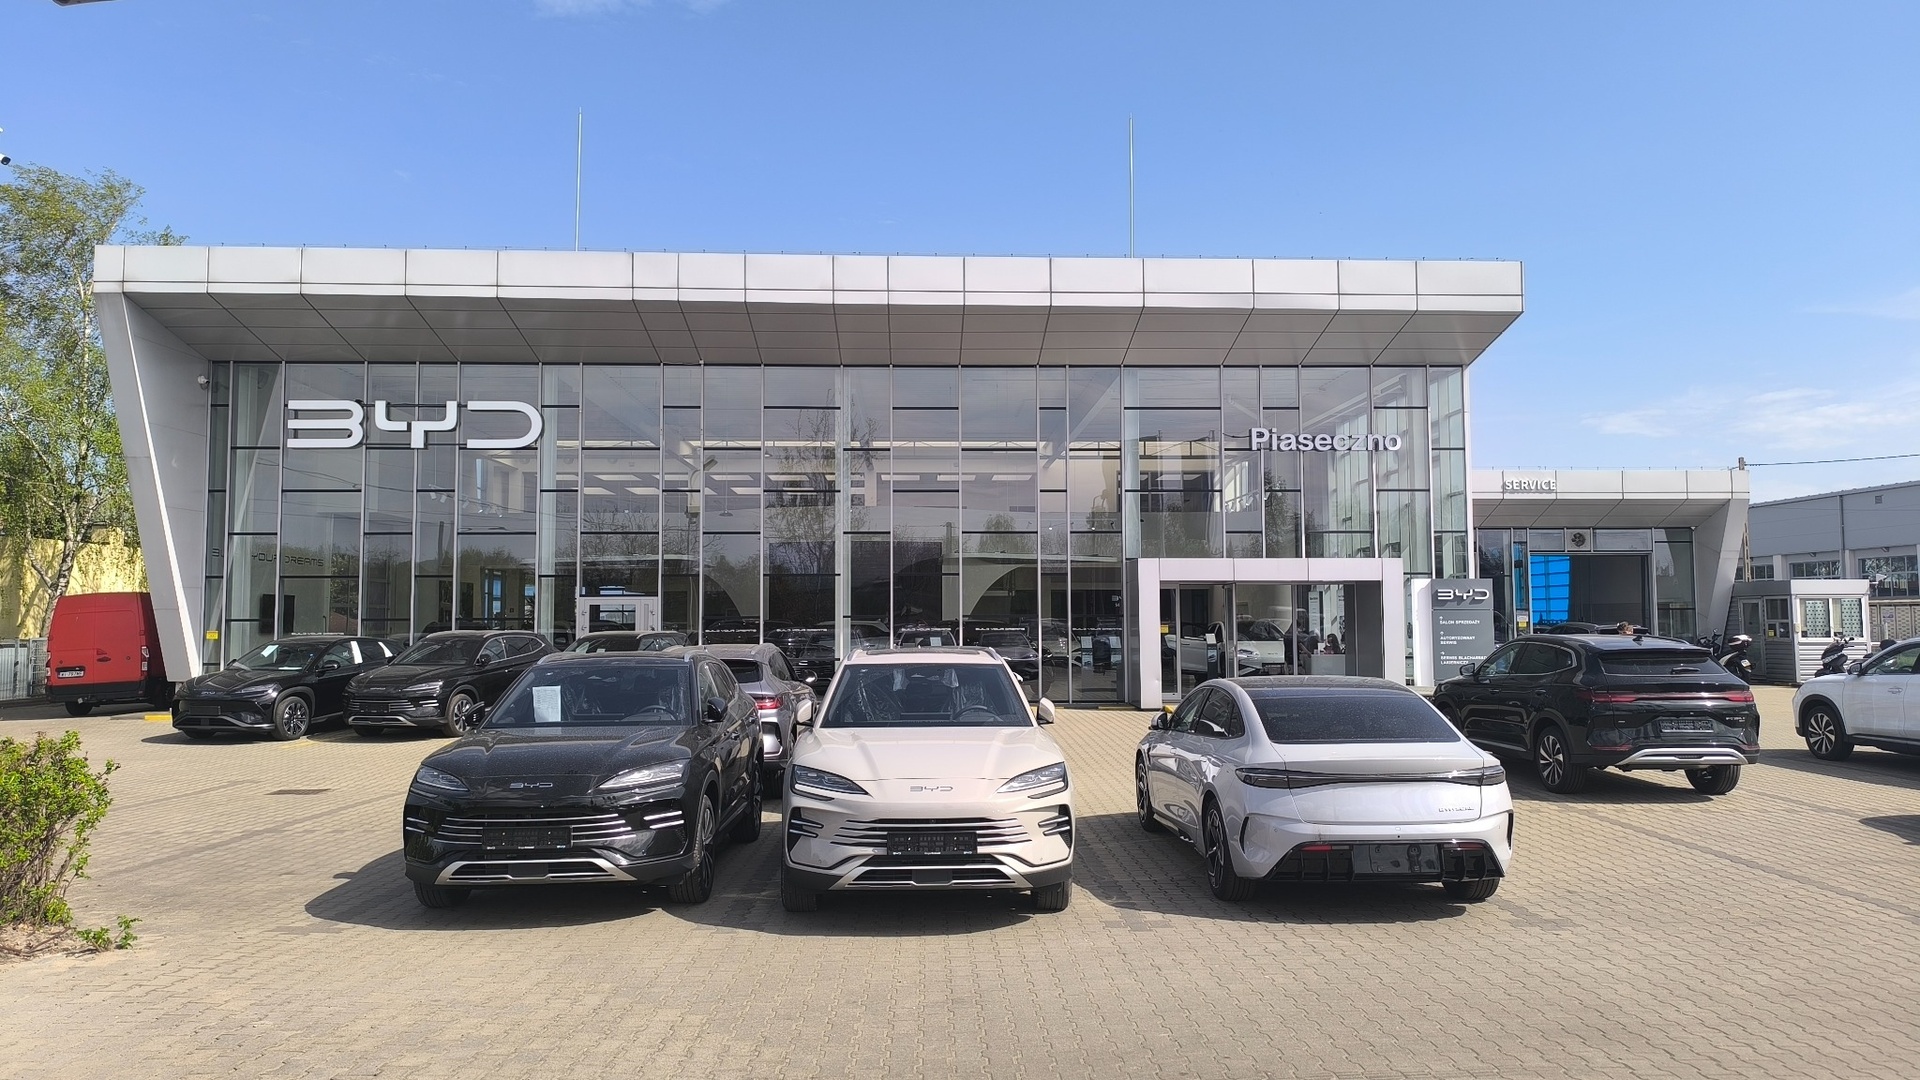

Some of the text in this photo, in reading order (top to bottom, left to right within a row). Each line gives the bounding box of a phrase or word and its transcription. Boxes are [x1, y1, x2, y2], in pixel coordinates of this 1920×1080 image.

[287, 400, 543, 448] BYD
[1251, 427, 1402, 451] Piaseczno
[1505, 480, 1556, 490] SERVICE
[285, 555, 324, 567] DREAMS
[1438, 589, 1489, 599] BYD
